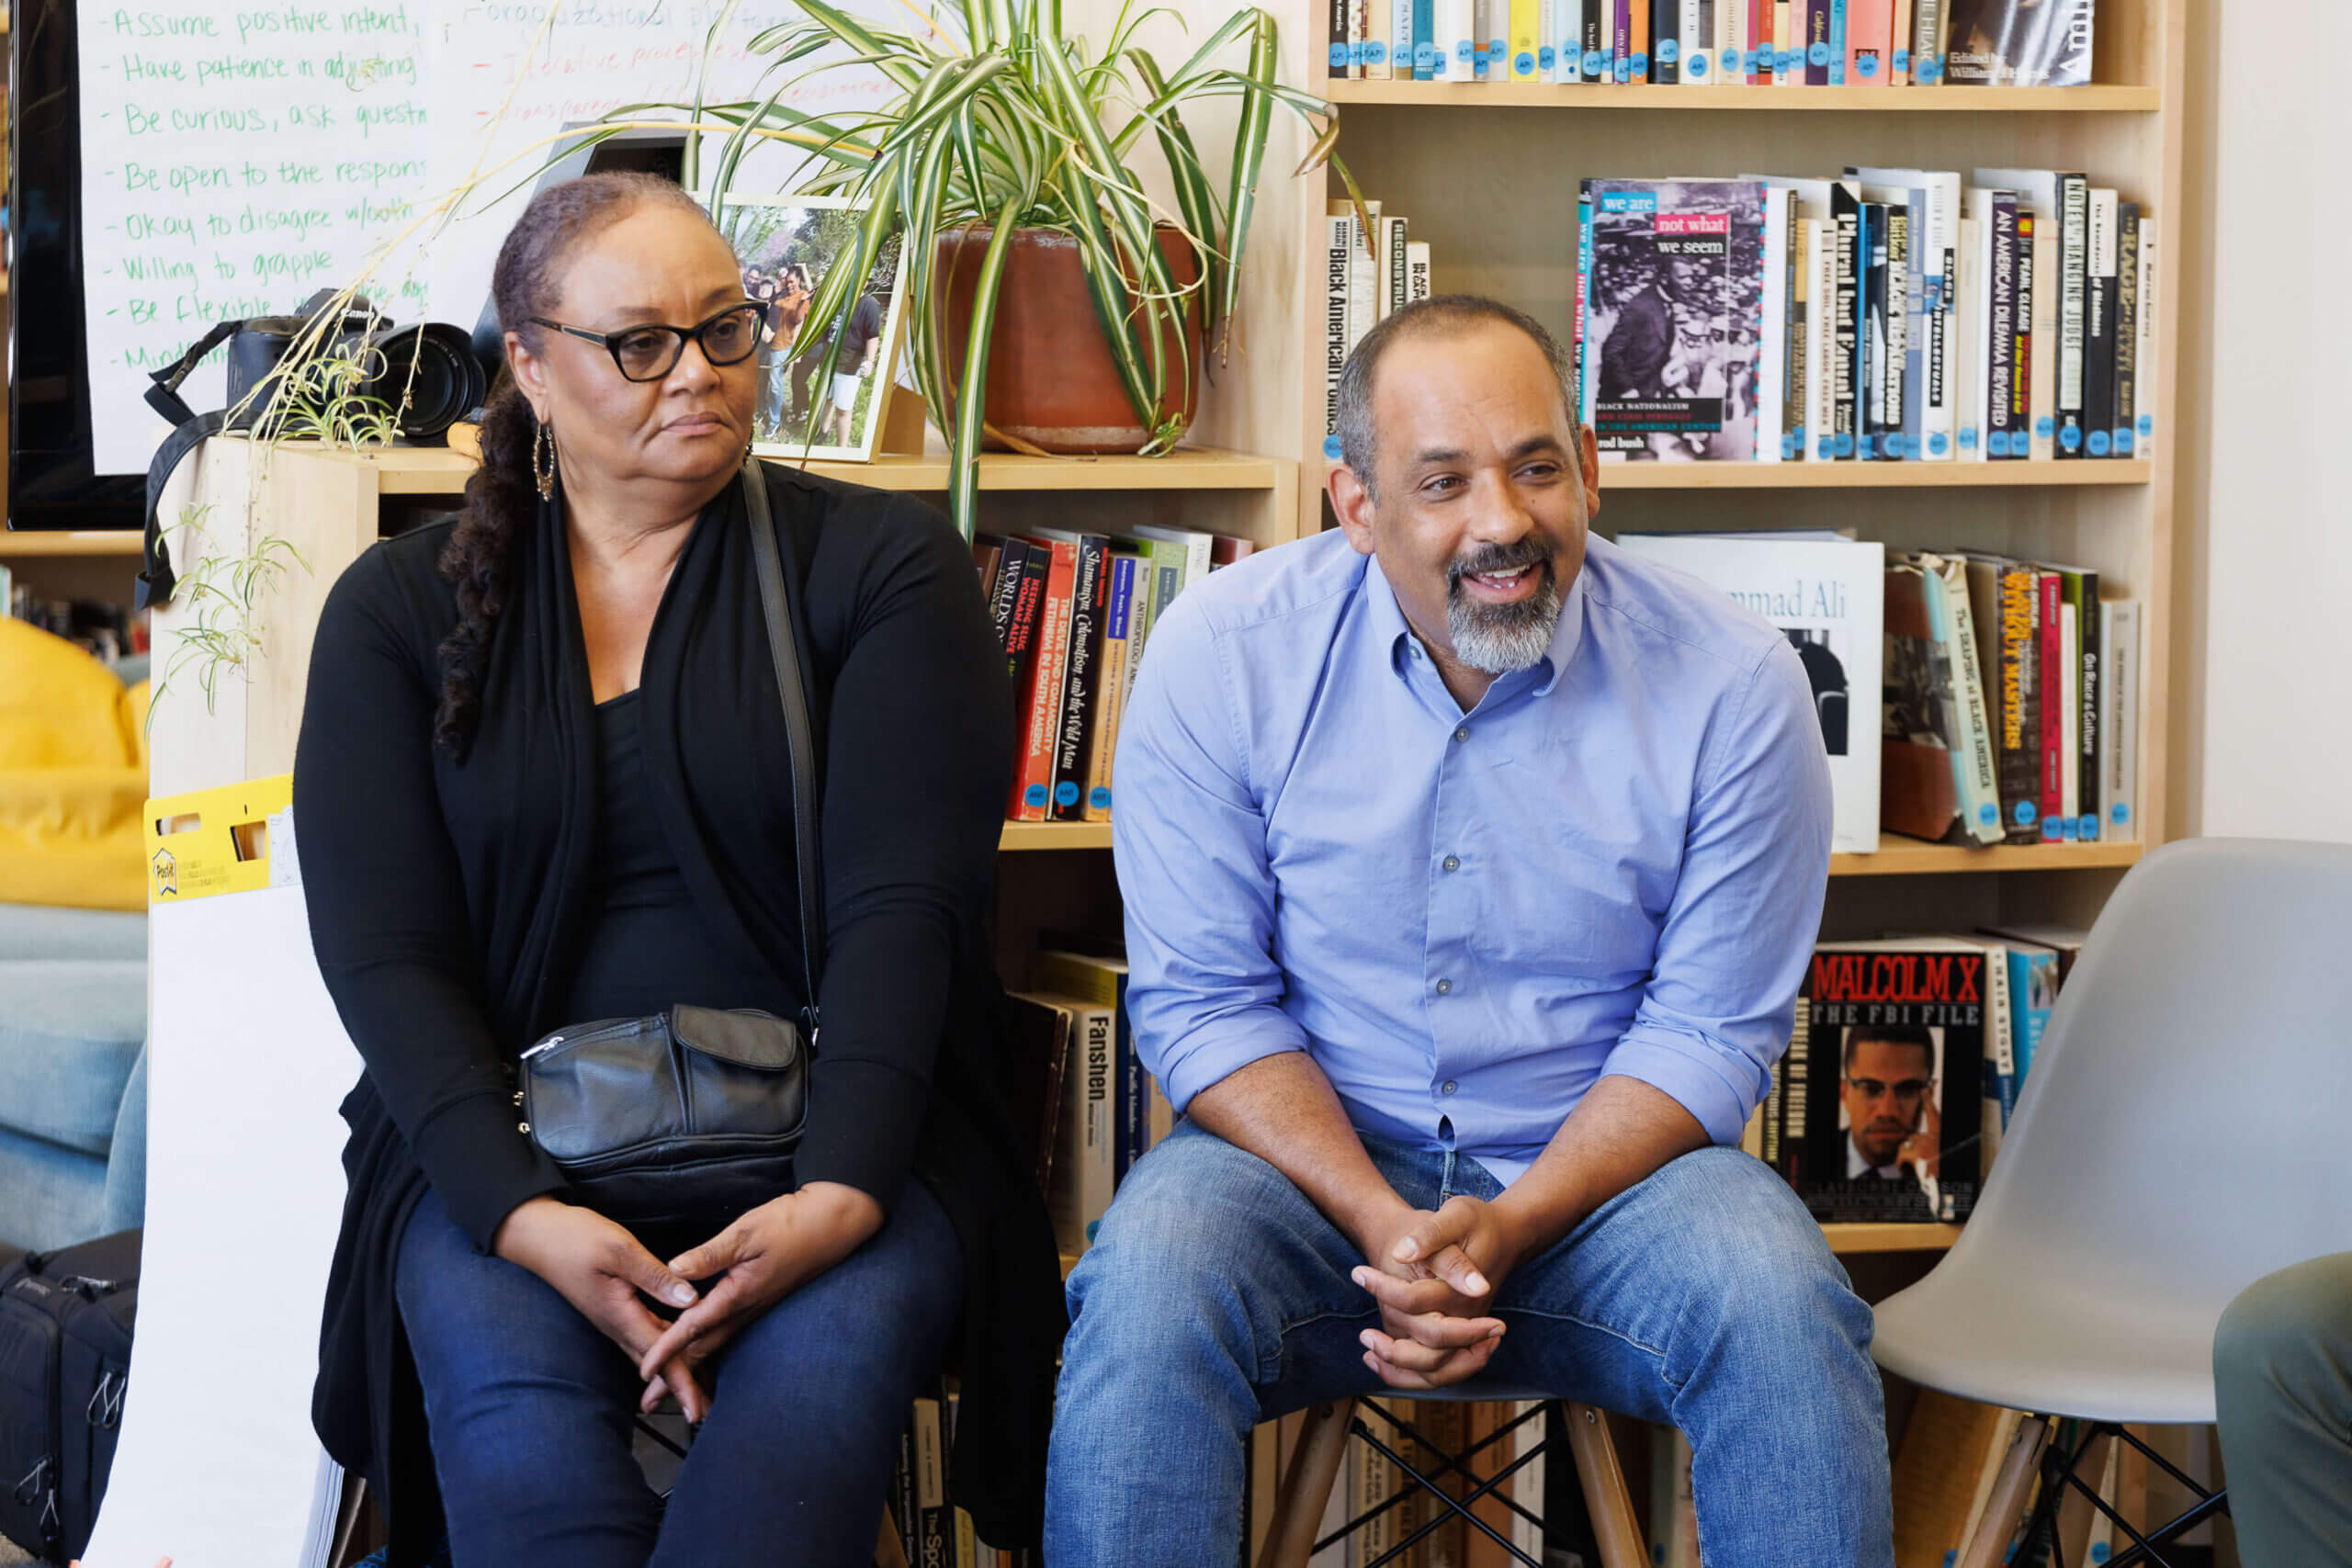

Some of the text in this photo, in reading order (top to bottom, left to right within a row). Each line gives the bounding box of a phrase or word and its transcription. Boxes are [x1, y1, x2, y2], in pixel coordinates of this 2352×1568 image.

[113, 8, 221, 38] Assume
[236, 5, 332, 47] positive
[122, 54, 186, 83] Have
[197, 53, 286, 87] patience
[298, 56, 314, 77] in
[125, 103, 334, 136] Be curious, ask
[125, 162, 162, 191] Be
[168, 164, 233, 197] open
[243, 160, 268, 186] to
[275, 160, 324, 186] the
[1603, 198, 1655, 210] we are
[1658, 216, 1724, 231] not what
[2067, 184, 2083, 227] NOTES
[126, 203, 334, 247] Okay to disagree
[1657, 241, 1724, 254] we seem
[122, 248, 333, 292] Willing to grapple
[2066, 243, 2082, 303] HANGING
[130, 297, 162, 326] Be
[175, 292, 272, 323] flexible
[1329, 248, 1348, 376] Black American
[1836, 213, 1857, 400] Plural but Equal
[2018, 257, 2031, 332] PEARL CLEAGE
[1992, 210, 2011, 427] AN AMERICAN DILEMMA REVISITED
[2065, 309, 2081, 350] JUDGE
[1598, 435, 1645, 448] rod bush
[995, 559, 1023, 625] WORLDS
[1012, 576, 1032, 626] WOMAN
[1023, 578, 1041, 623] KEEPING
[1814, 580, 1847, 619] Ali
[1016, 625, 1030, 651] SLUG
[1042, 653, 1052, 667] IN
[1045, 598, 1070, 753] THE DEVIL AND COMMODITY
[1069, 697, 1085, 715] the
[1071, 678, 1086, 698] and
[1065, 715, 1082, 742] Wild
[1061, 740, 1078, 770] Man
[1813, 954, 1982, 1003] MALCOLM X
[1812, 1005, 1979, 1026] THE FBI FILE
[1088, 1016, 1110, 1100] Fanshen
